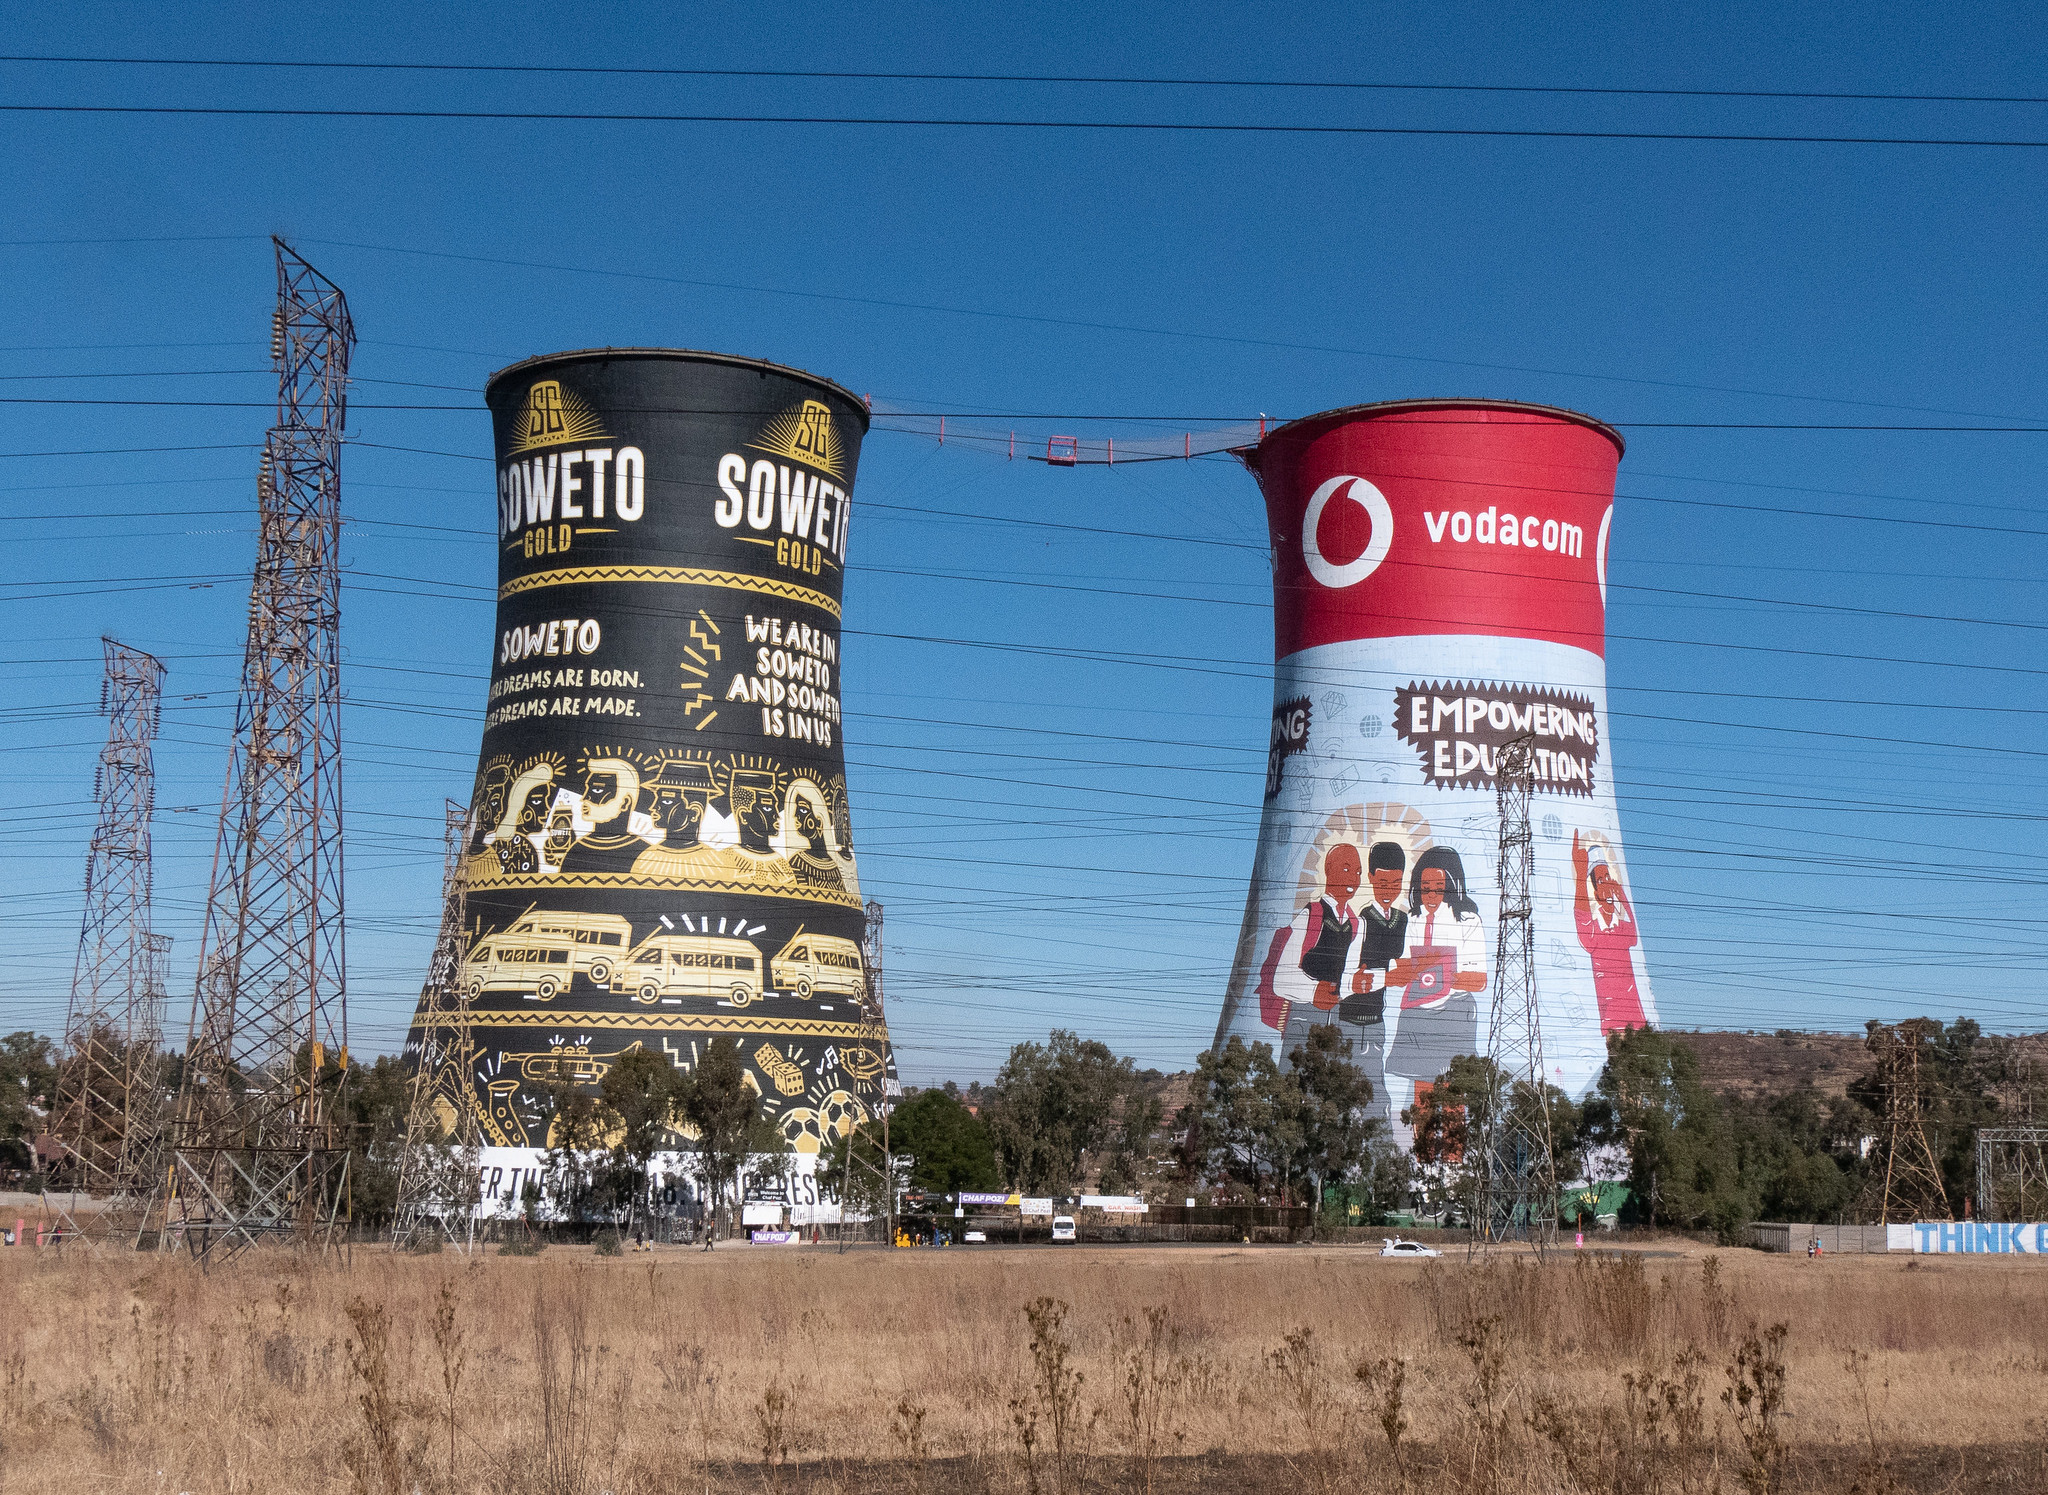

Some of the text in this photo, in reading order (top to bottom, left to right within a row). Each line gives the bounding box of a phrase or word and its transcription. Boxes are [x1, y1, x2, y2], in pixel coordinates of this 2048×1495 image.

[500, 446, 644, 541] SOWETO
[714, 453, 851, 565] SOWETO
[524, 524, 571, 558] GOLD
[1424, 506, 1582, 558] vodacom
[776, 537, 822, 576] GOLD
[501, 618, 600, 666] SOWETO
[744, 614, 836, 665] WE ARE IN
[502, 670, 552, 696] DREAMS
[553, 668, 583, 688] ARE
[590, 669, 645, 689] BORN.
[756, 646, 830, 691] SOWETO
[499, 698, 548, 724] DREAMS
[549, 696, 580, 716] ARE
[584, 697, 642, 718] MADE.
[725, 673, 840, 726] AND SOWETO
[761, 707, 832, 749] IS IN US
[1411, 697, 1594, 746] EMPOWERING
[962, 1194, 985, 1203] CHAF
[985, 1195, 1005, 1203] POZI
[754, 1233, 771, 1241] CHAF
[1916, 1223, 2027, 1253] THINK
